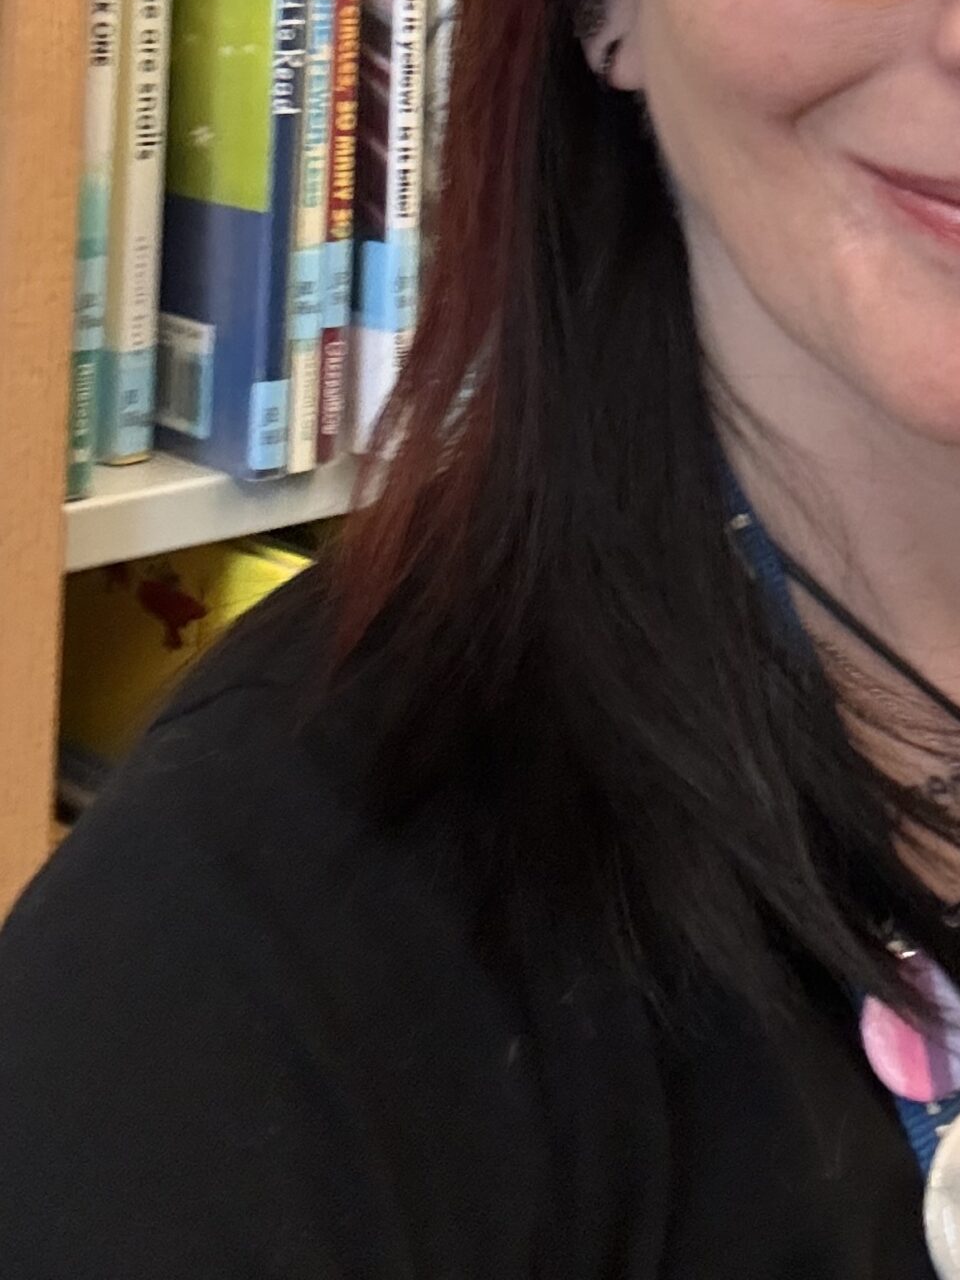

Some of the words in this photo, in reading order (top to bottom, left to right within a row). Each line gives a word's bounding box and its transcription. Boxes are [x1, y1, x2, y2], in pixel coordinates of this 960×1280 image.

[91, 21, 113, 67] ONE
[139, 28, 161, 72] are
[272, 49, 306, 115] Read
[136, 83, 164, 161] snails
[332, 136, 357, 200] MANY
